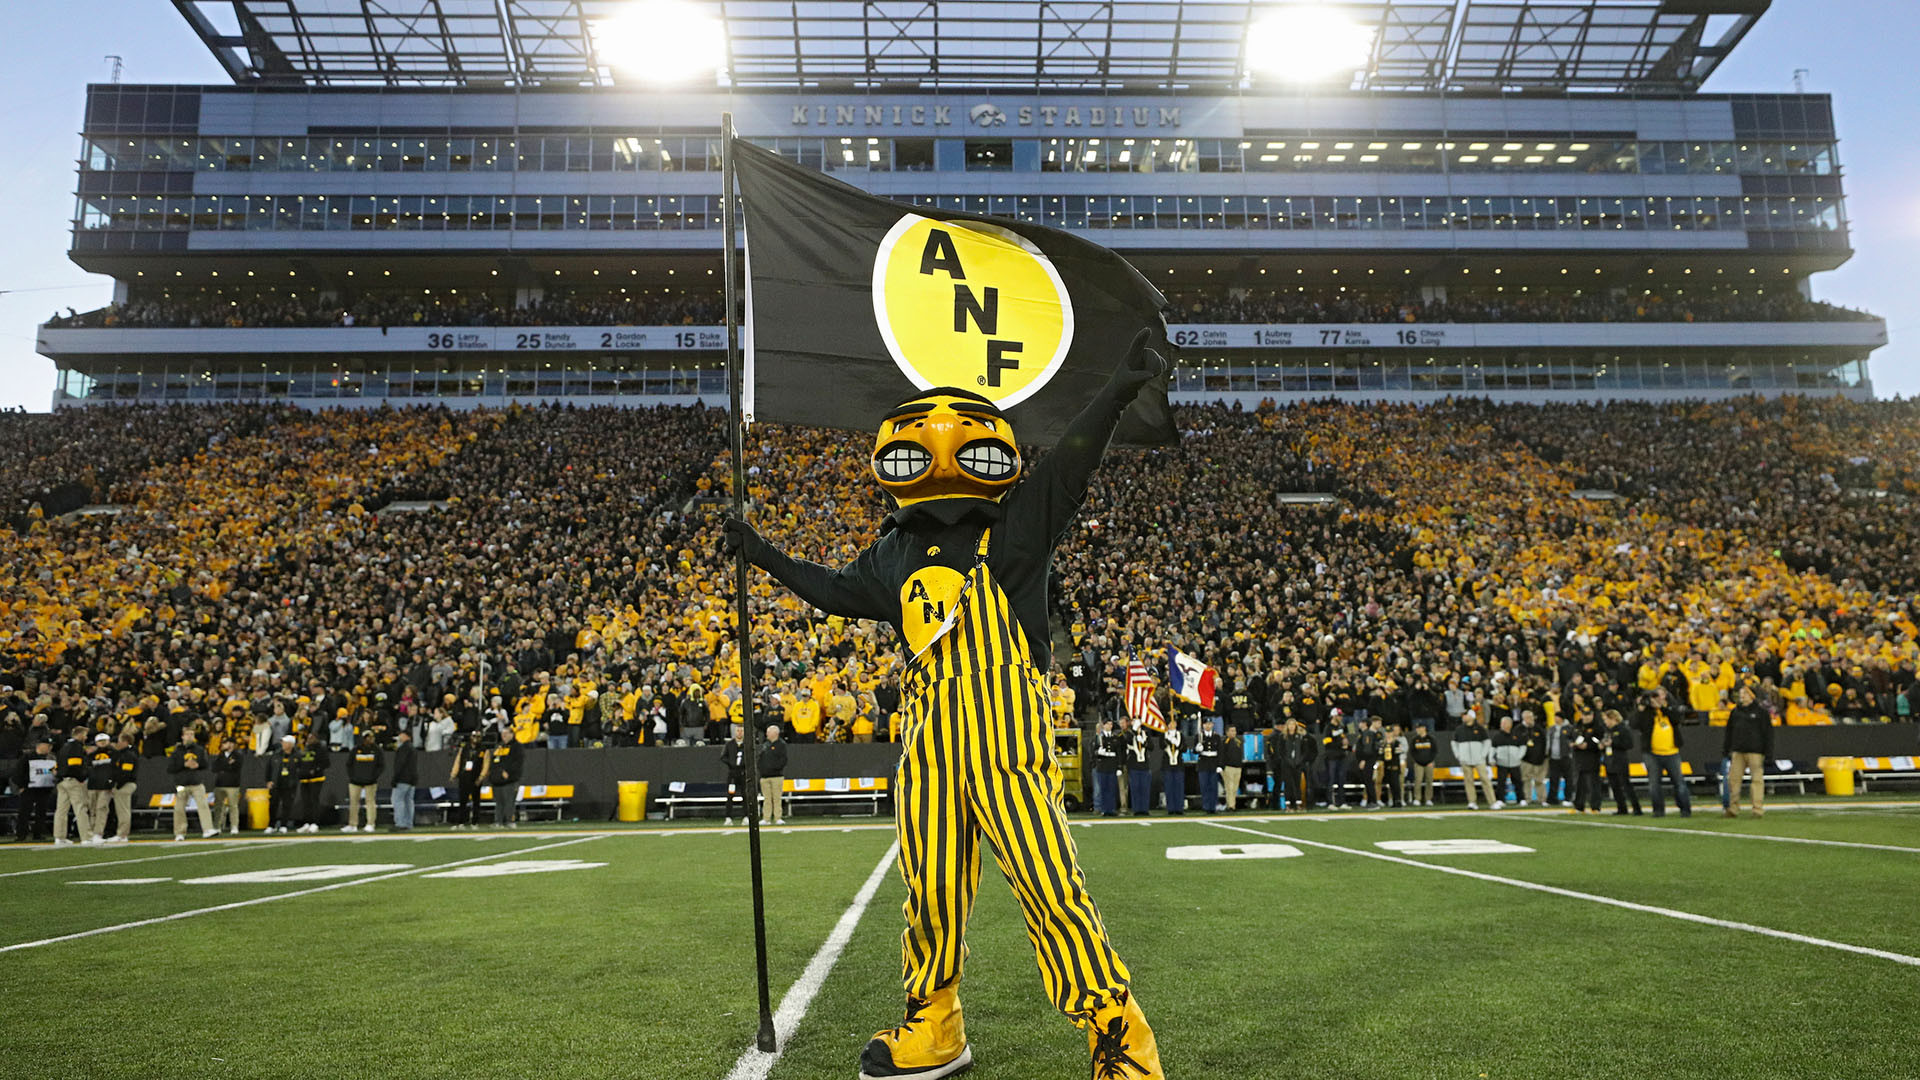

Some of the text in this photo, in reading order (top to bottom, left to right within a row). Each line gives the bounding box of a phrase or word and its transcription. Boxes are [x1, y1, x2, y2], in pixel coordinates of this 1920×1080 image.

[791, 105, 1182, 127] KINNICK STADIUM
[428, 333, 454, 349] 36
[458, 333, 480, 342] Larry
[516, 333, 541, 349] 25
[600, 333, 612, 348] 2
[616, 332, 646, 340] Gordon
[675, 332, 695, 348] 15
[700, 332, 720, 340] Duke
[1175, 331, 1199, 346] 62
[1203, 330, 1227, 338] Calvin
[1254, 330, 1261, 345] 1
[1319, 330, 1341, 345] 77
[1397, 330, 1417, 345] 16
[545, 341, 576, 349] Duncan
